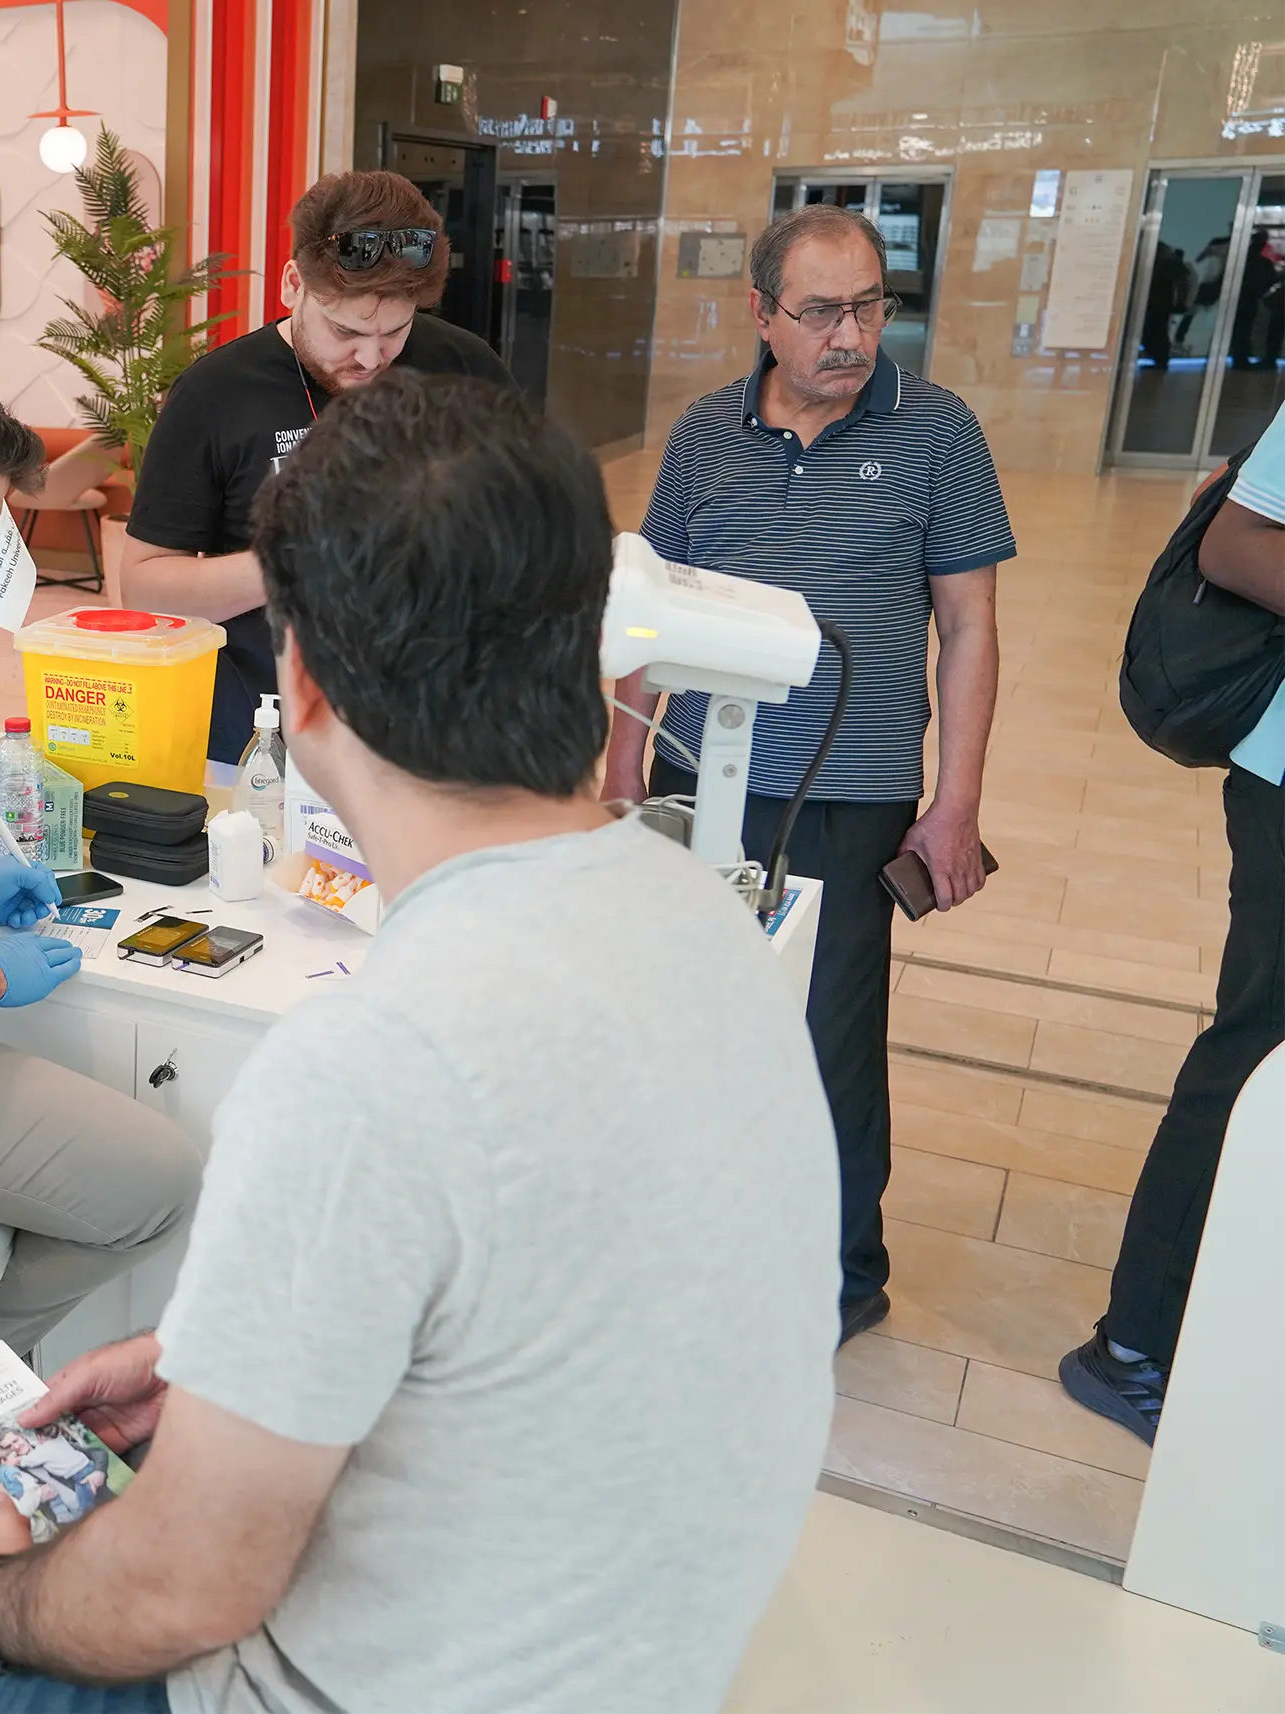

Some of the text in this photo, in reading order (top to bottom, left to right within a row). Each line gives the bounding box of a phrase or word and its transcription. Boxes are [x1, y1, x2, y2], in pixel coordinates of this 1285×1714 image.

[275, 428, 313, 443] CONVEN
[45, 677, 64, 686] WARNING
[74, 680, 82, 688] NOT
[83, 681, 91, 689] FILL
[92, 682, 107, 691] ABOVE
[107, 684, 117, 693] THIS
[117, 685, 127, 694] LINE
[45, 685, 106, 706] DANGER
[46, 710, 68, 721] DESTROY
[74, 714, 106, 726] INCINERATION
[308, 822, 354, 848] ACCU-CHEK
